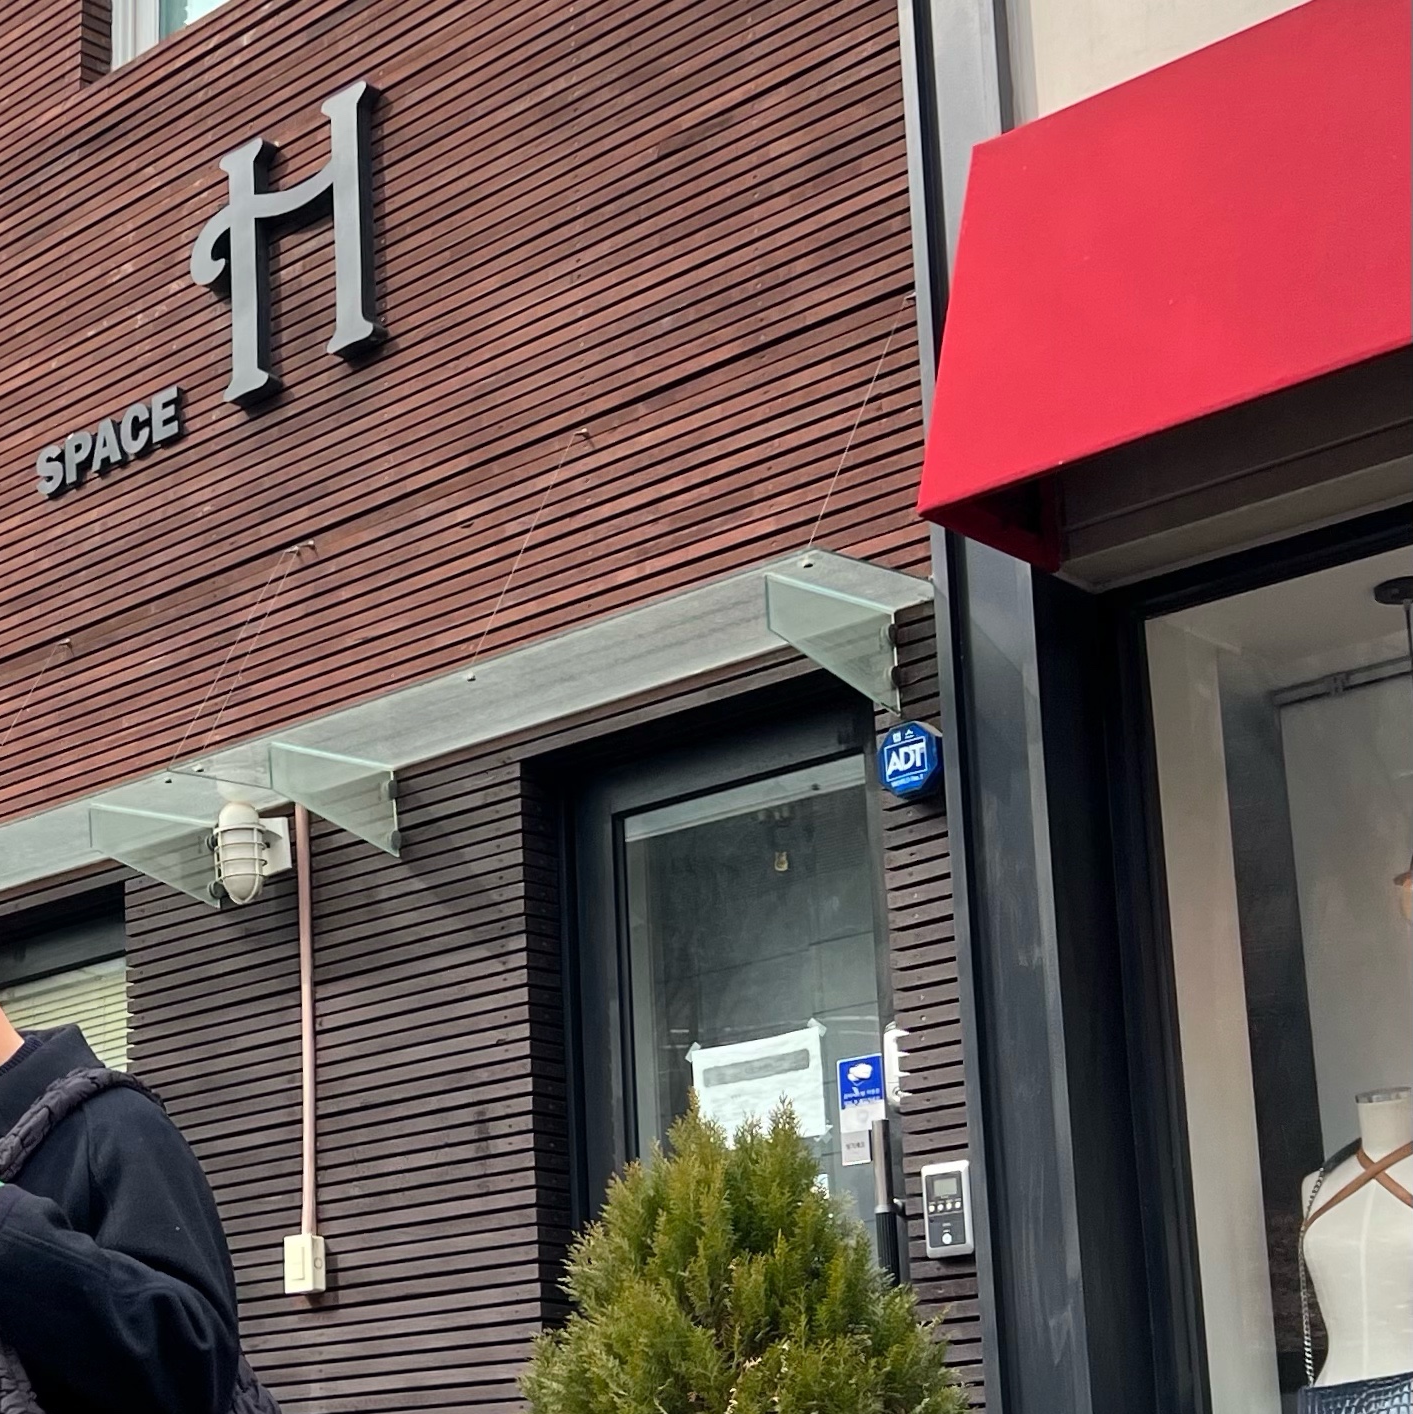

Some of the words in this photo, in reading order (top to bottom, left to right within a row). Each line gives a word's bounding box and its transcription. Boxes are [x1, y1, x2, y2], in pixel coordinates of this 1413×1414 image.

[36, 385, 182, 497] SPACE
[190, 80, 381, 404] H
[887, 742, 926, 776] ADT
